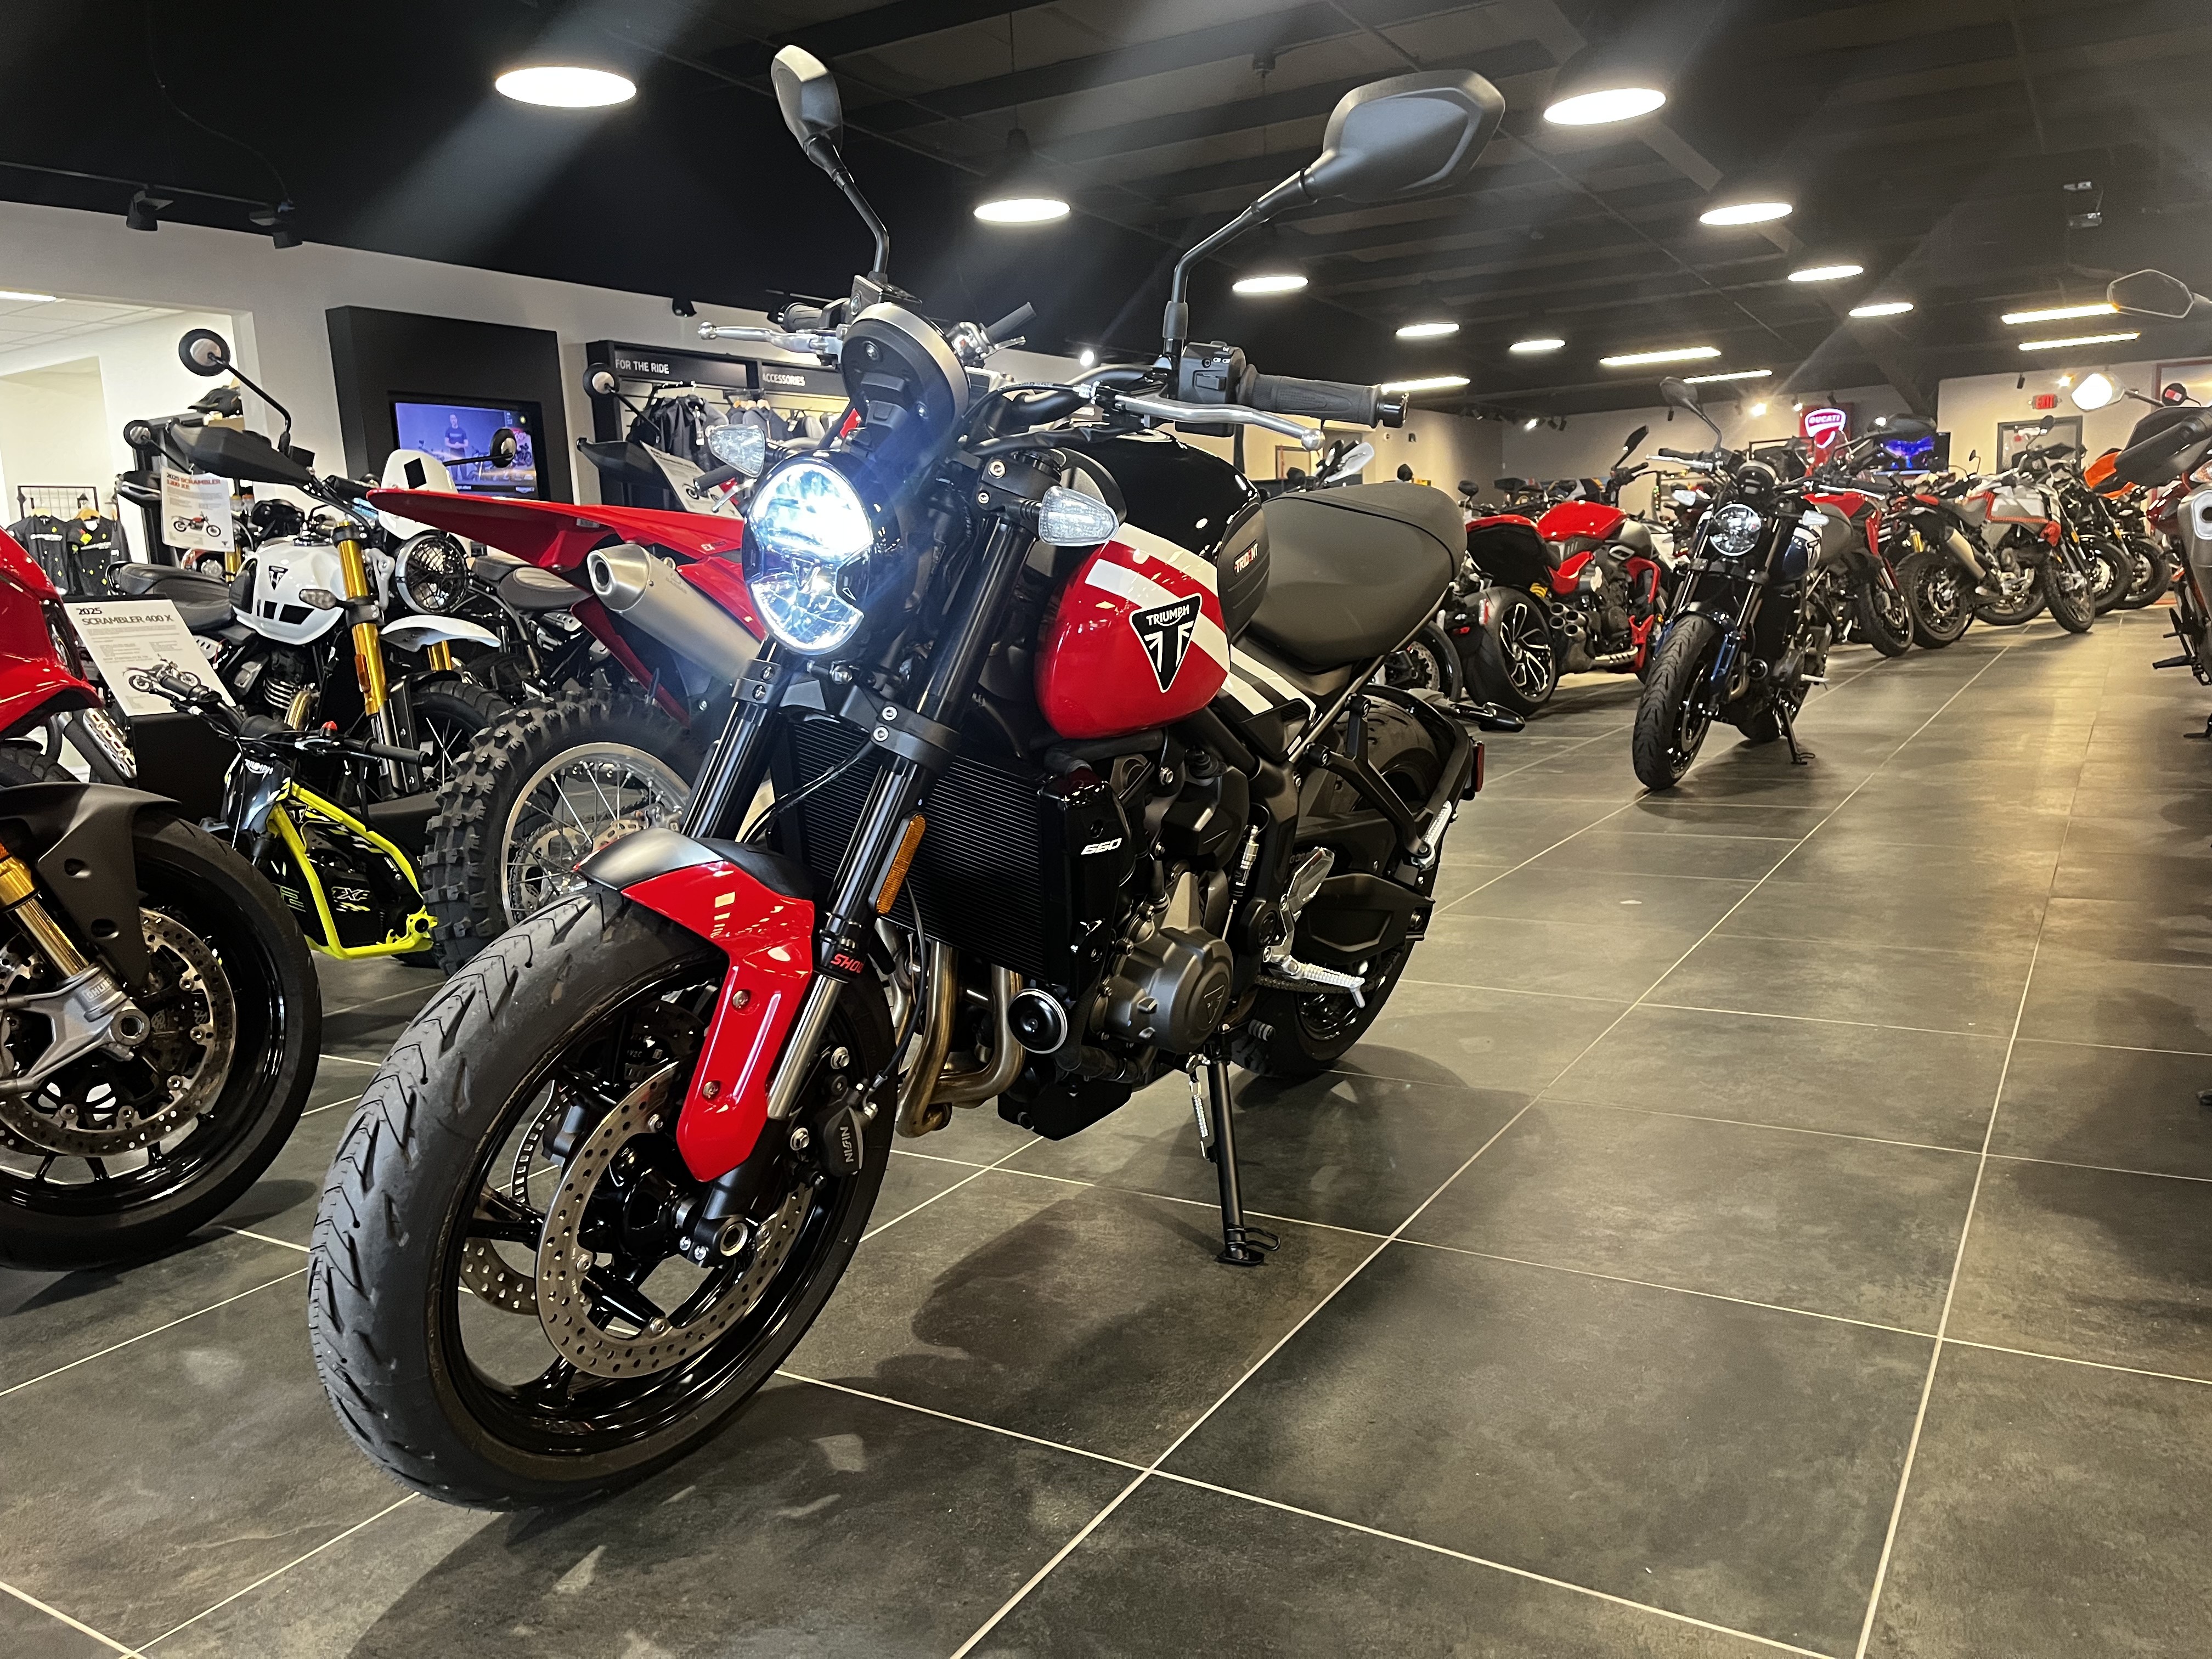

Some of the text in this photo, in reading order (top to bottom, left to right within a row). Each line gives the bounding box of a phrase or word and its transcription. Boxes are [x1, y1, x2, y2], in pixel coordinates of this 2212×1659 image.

[616, 359, 669, 375] FOR THE RIDE
[763, 373, 805, 387] ACCESSORIES
[1809, 414, 1841, 424] DUCATI
[1234, 543, 1259, 573] TRIDENT
[82, 616, 146, 625] SCRAMBLER
[1146, 604, 1190, 627] TRIUMPH
[1080, 837, 1122, 855] 660
[840, 1126, 854, 1163] NISSIN
